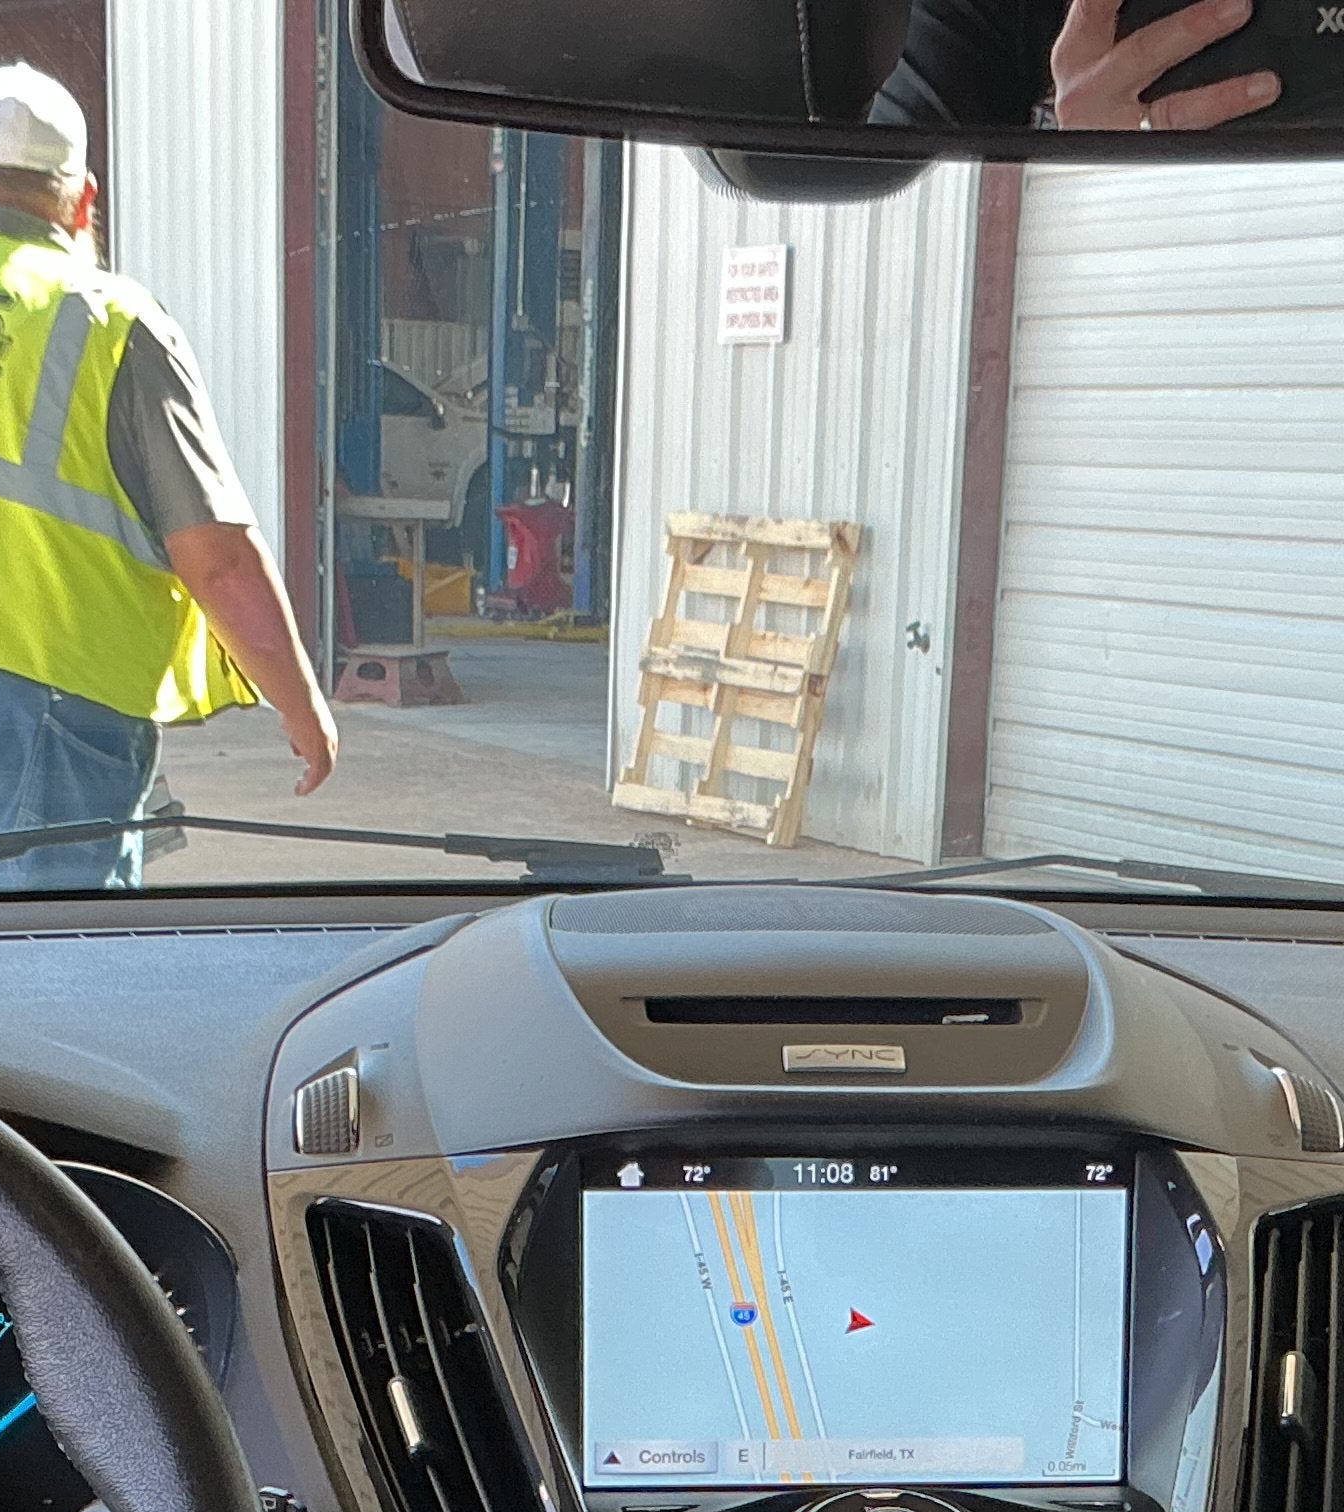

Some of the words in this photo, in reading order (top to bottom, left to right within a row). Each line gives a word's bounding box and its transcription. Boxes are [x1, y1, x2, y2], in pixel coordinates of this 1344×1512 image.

[795, 1048, 897, 1062] SYNC
[682, 1164, 712, 1183] 72°
[792, 1162, 855, 1184] 11:08
[869, 1164, 899, 1182] 81°
[1084, 1164, 1114, 1182] 72°
[638, 1448, 707, 1465] Controls
[738, 1449, 749, 1463] E
[848, 1448, 898, 1462] Fairfield,
[902, 1448, 915, 1460] TX
